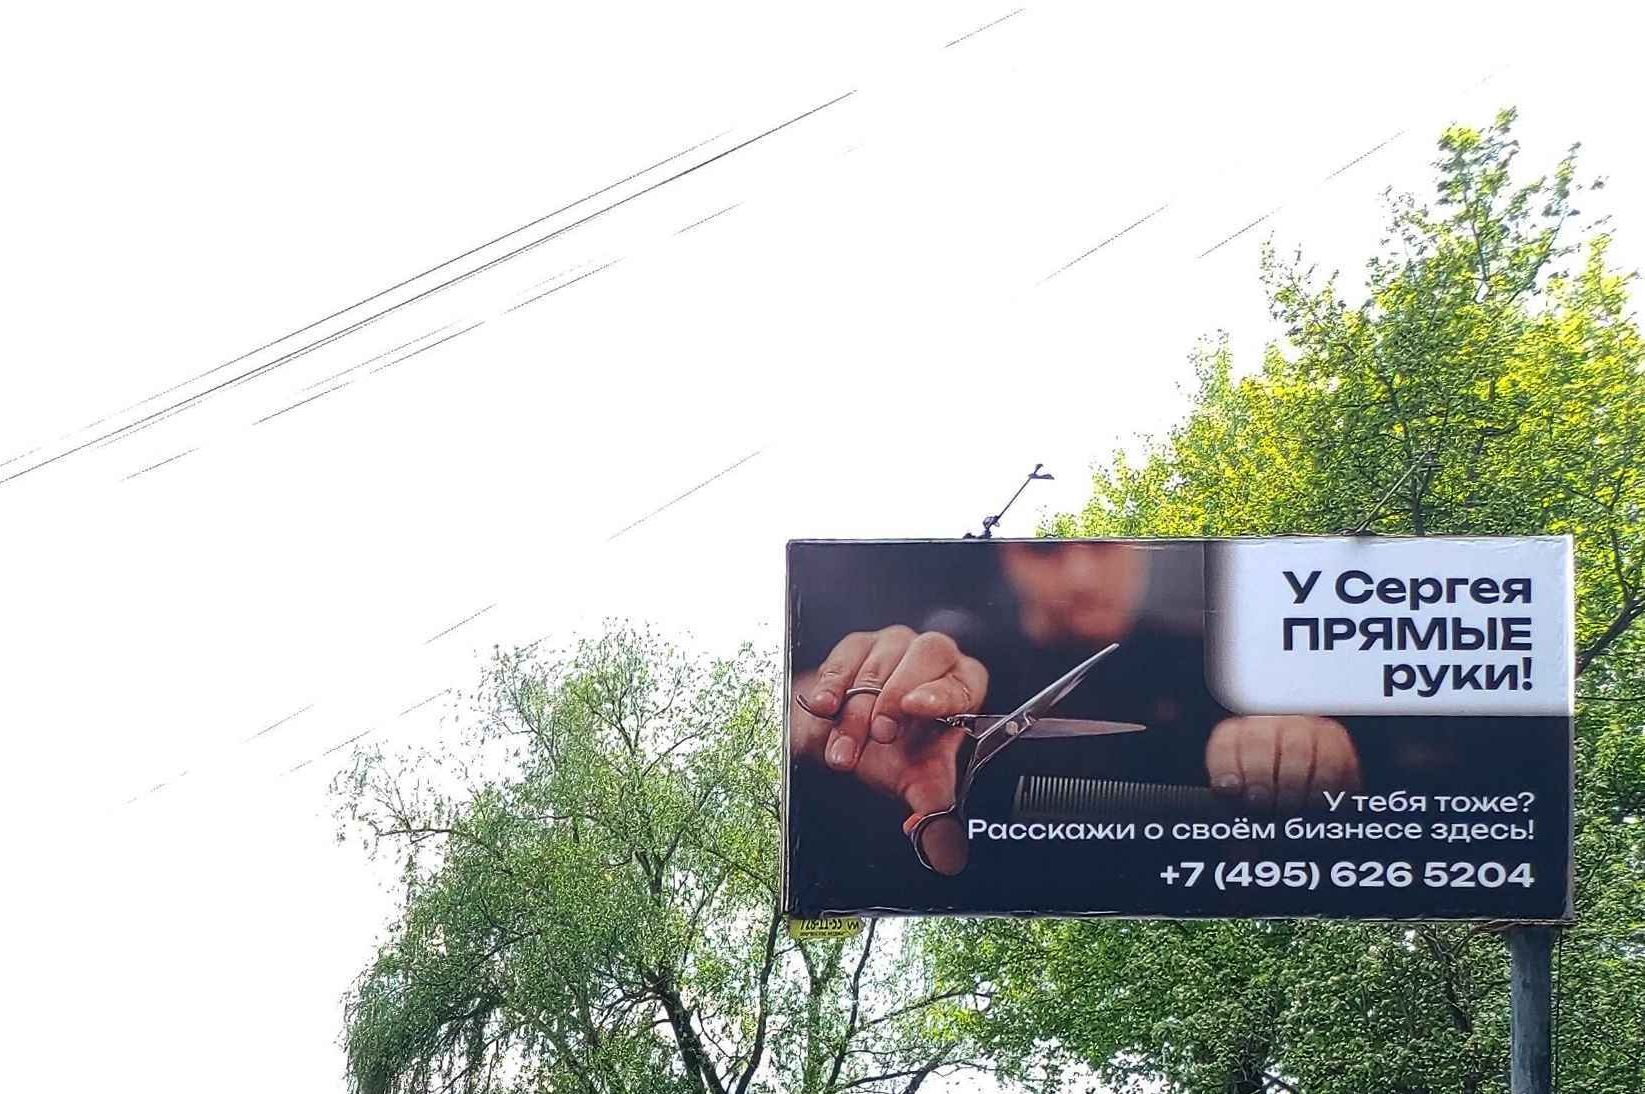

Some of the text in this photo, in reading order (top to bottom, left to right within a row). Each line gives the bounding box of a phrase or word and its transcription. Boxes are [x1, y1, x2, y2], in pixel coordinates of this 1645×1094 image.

[1282, 570, 1532, 610] У Сергея
[1283, 617, 1532, 651] ПРЯМЫЕ
[1383, 657, 1533, 697] руки!
[1323, 791, 1535, 812] У тебя тоже?
[968, 817, 1534, 843] Расскажи о своём бизнесе здесь!
[1160, 861, 1535, 890] +7 (495) 626 5204
